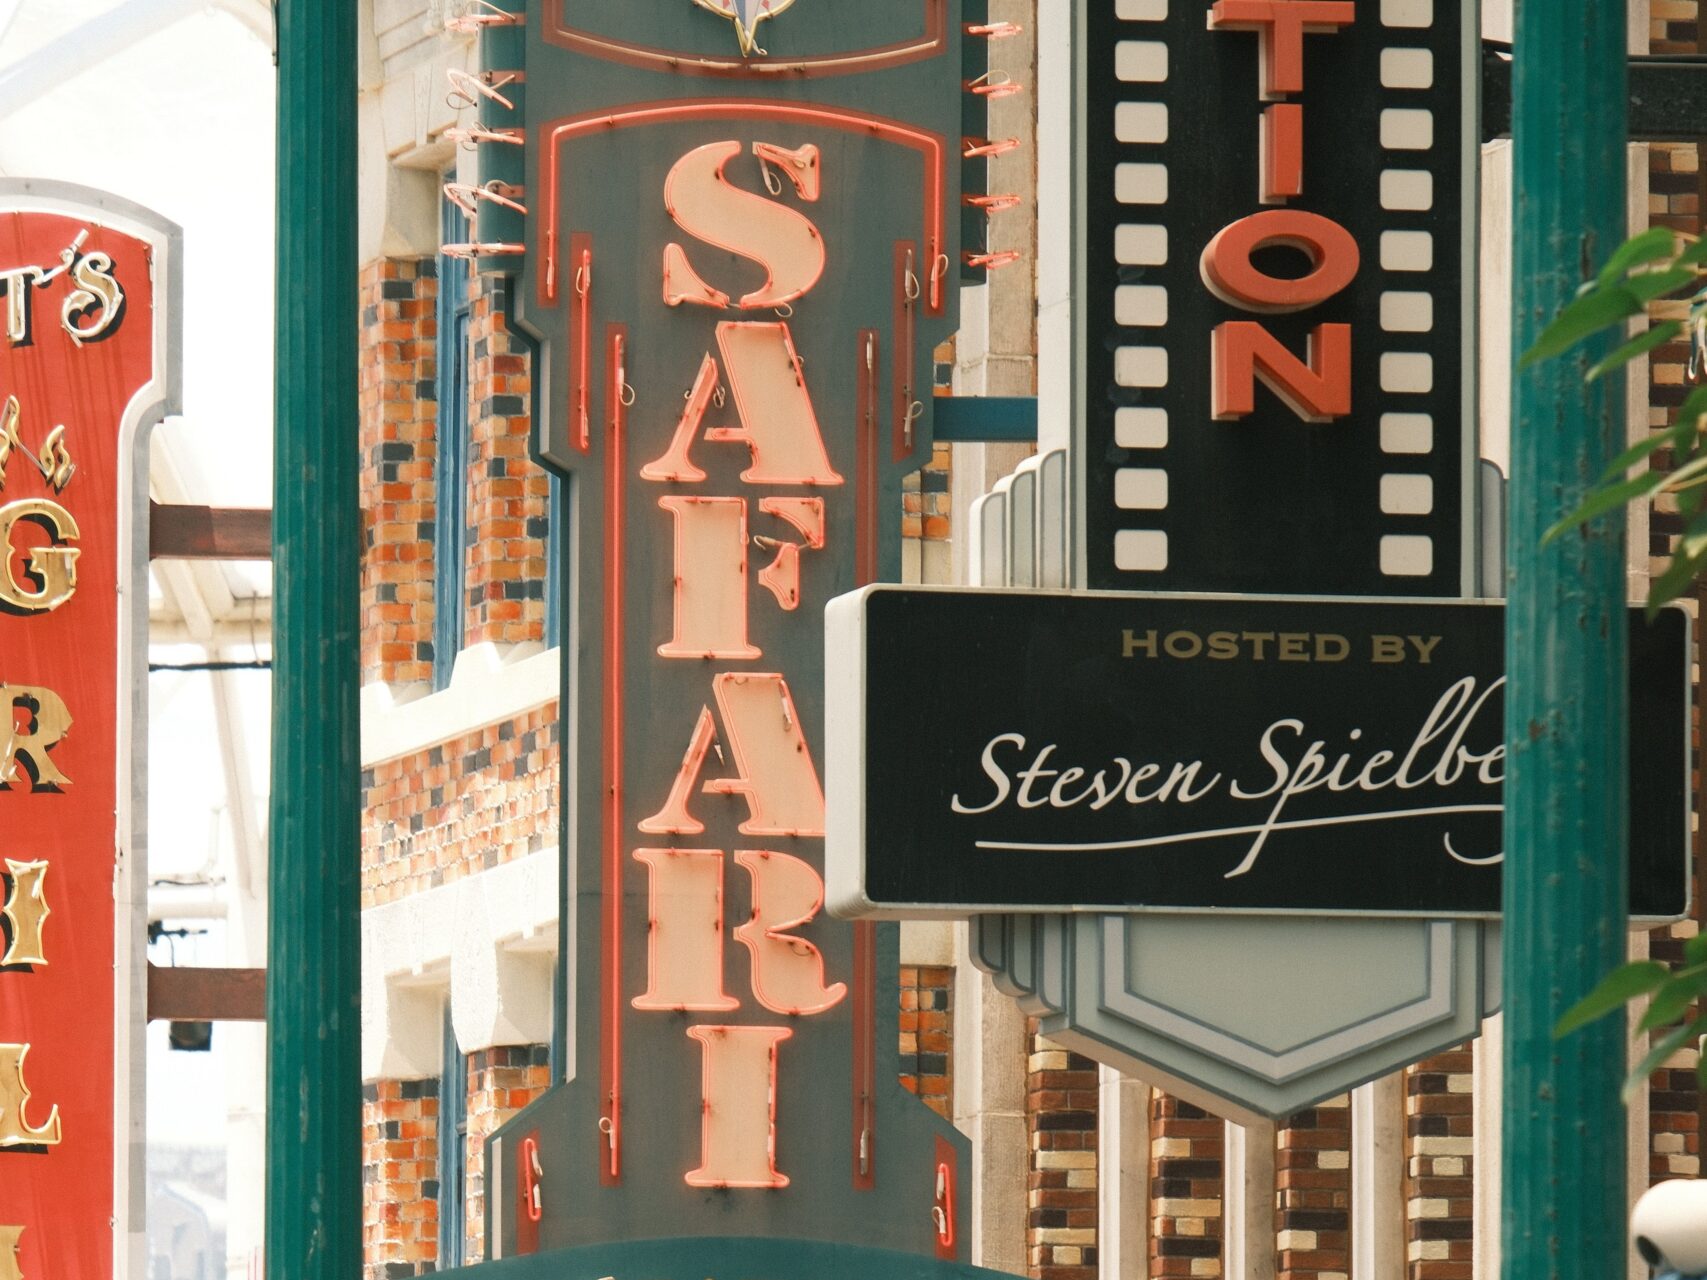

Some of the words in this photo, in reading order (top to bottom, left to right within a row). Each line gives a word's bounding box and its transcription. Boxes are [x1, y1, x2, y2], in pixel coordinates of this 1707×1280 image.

[631, 140, 848, 1188] SAFARI
[1121, 628, 1350, 662] HOSTED
[1371, 632, 1443, 664] BY
[951, 732, 1222, 815] Steven
[1224, 675, 1506, 880] Spielbe
